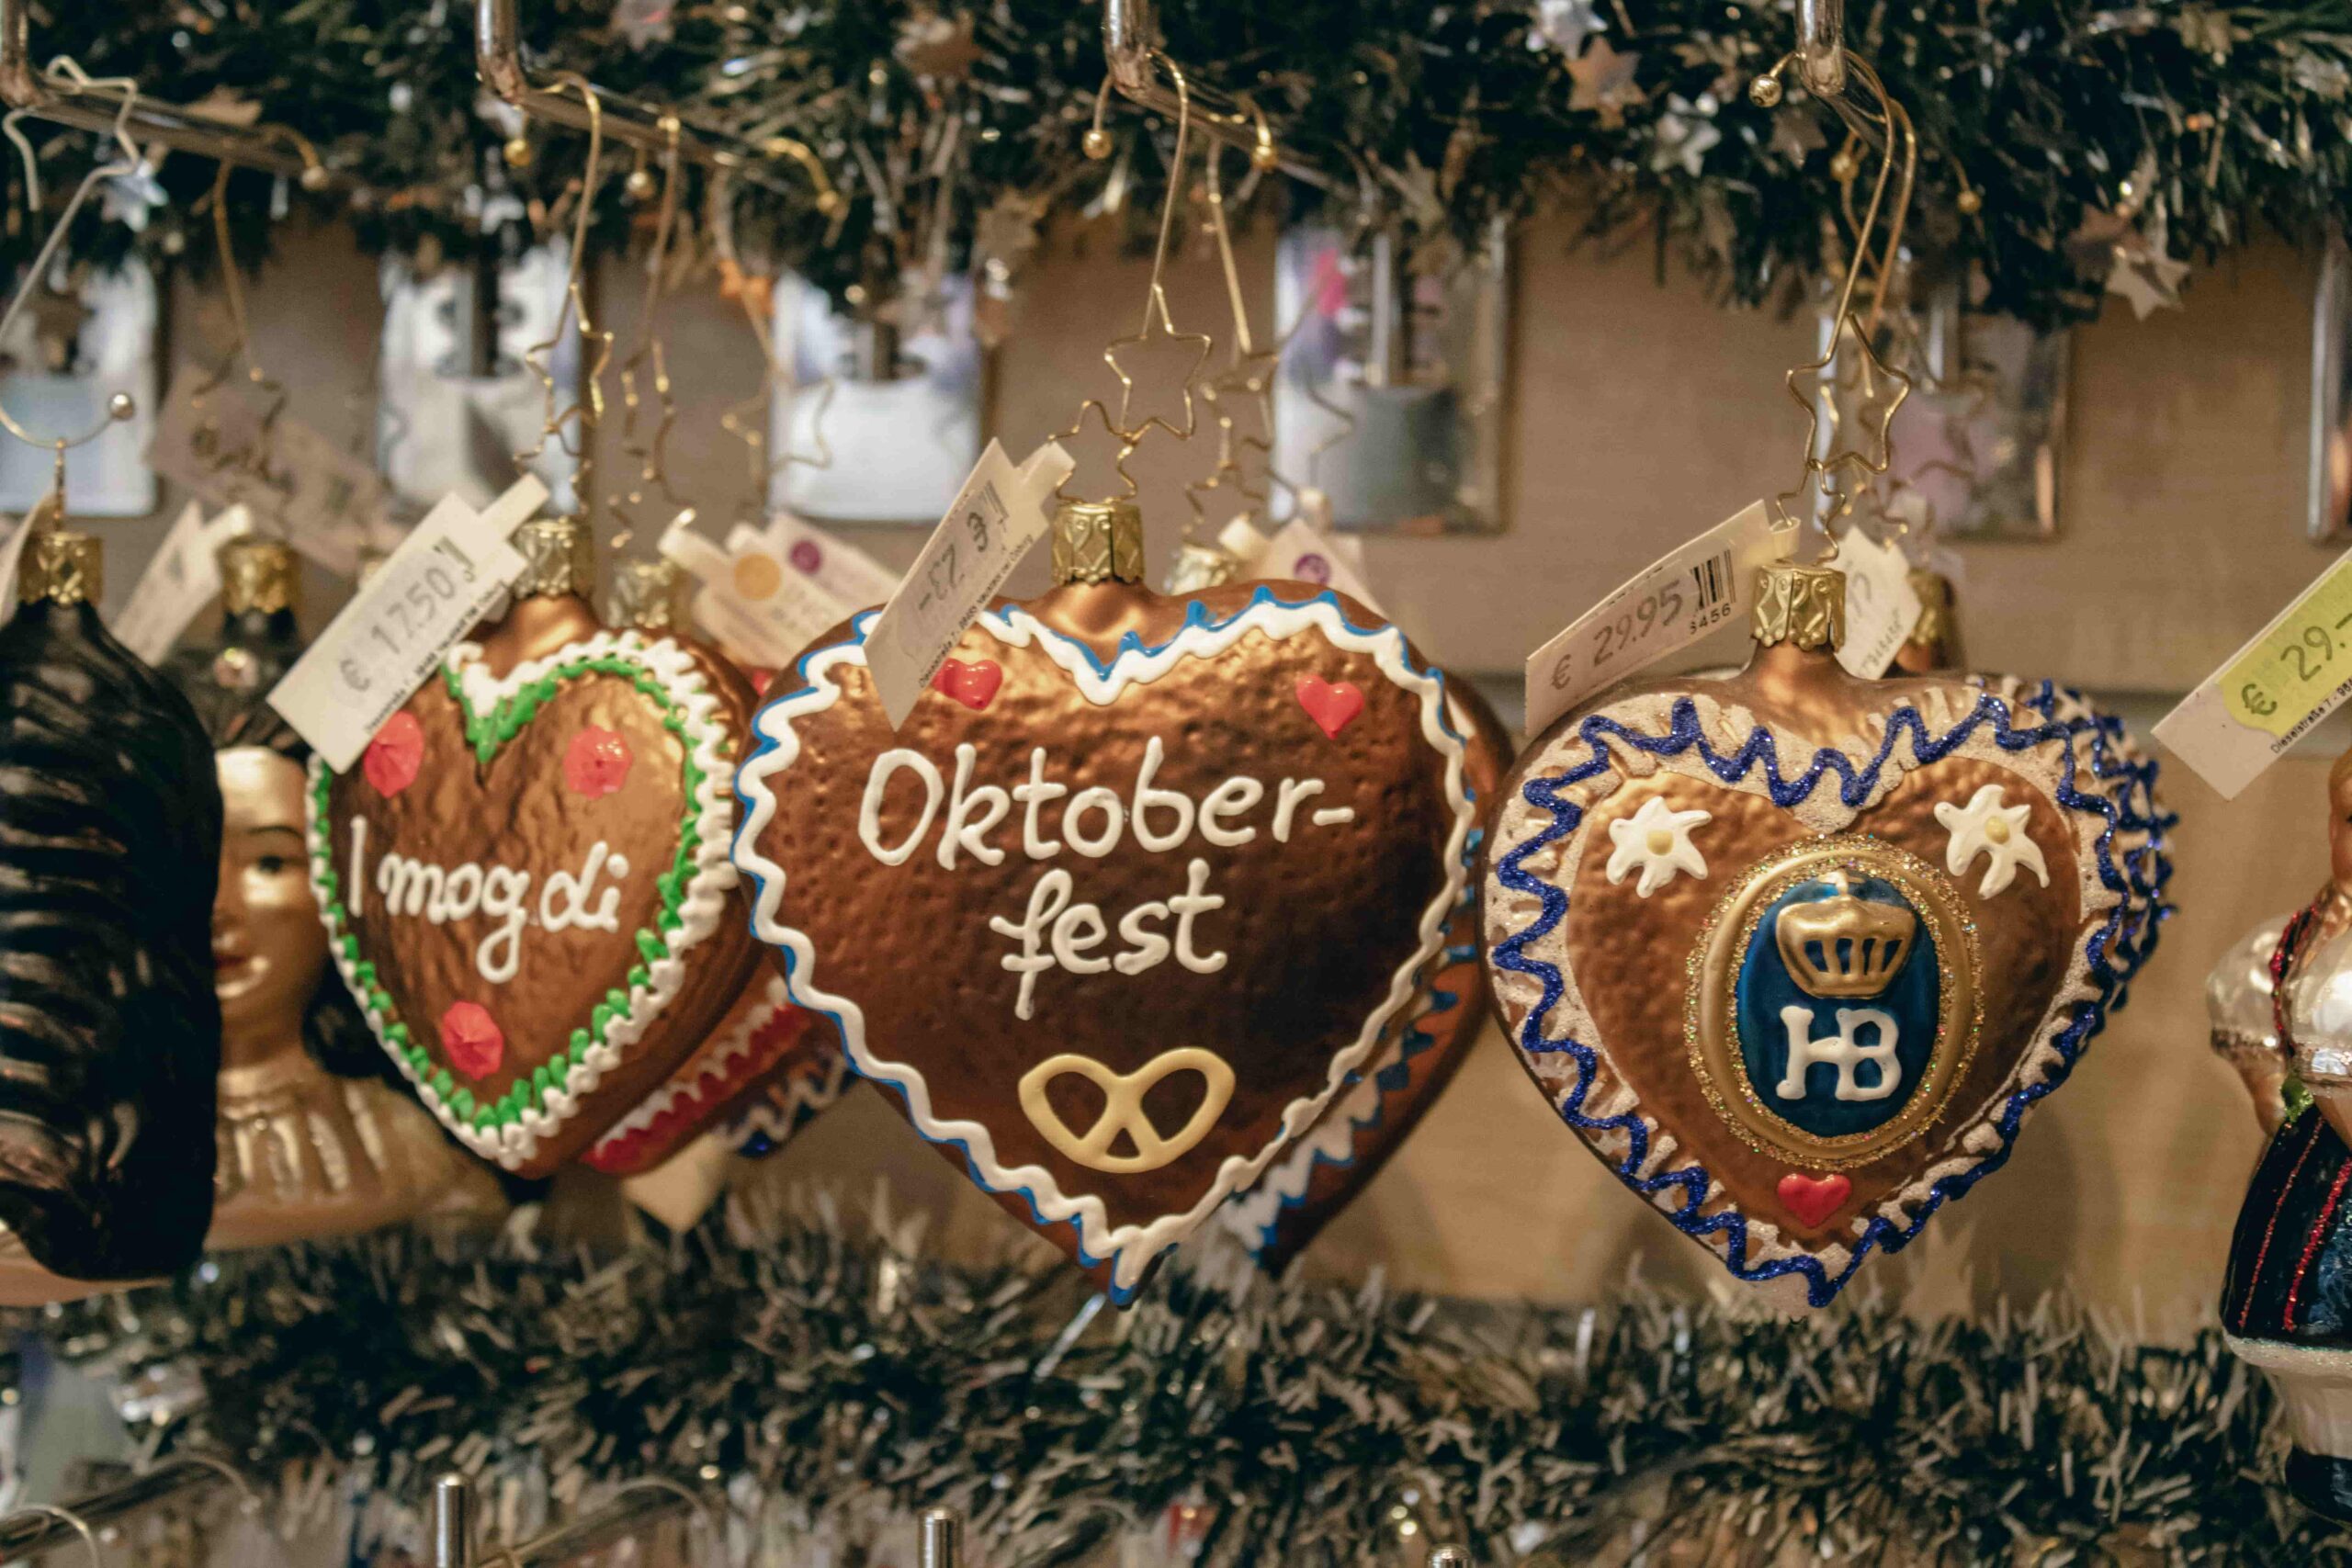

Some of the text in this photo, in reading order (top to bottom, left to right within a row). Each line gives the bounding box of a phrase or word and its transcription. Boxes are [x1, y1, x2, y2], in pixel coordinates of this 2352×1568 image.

[340, 658, 371, 693] €
[1551, 579, 1683, 690] € 29.95
[2241, 683, 2278, 716] €
[858, 736, 1355, 871] Oktober-
[348, 814, 629, 984] I mog di
[989, 857, 1227, 1021] fest
[1775, 1005, 1902, 1101] HB
